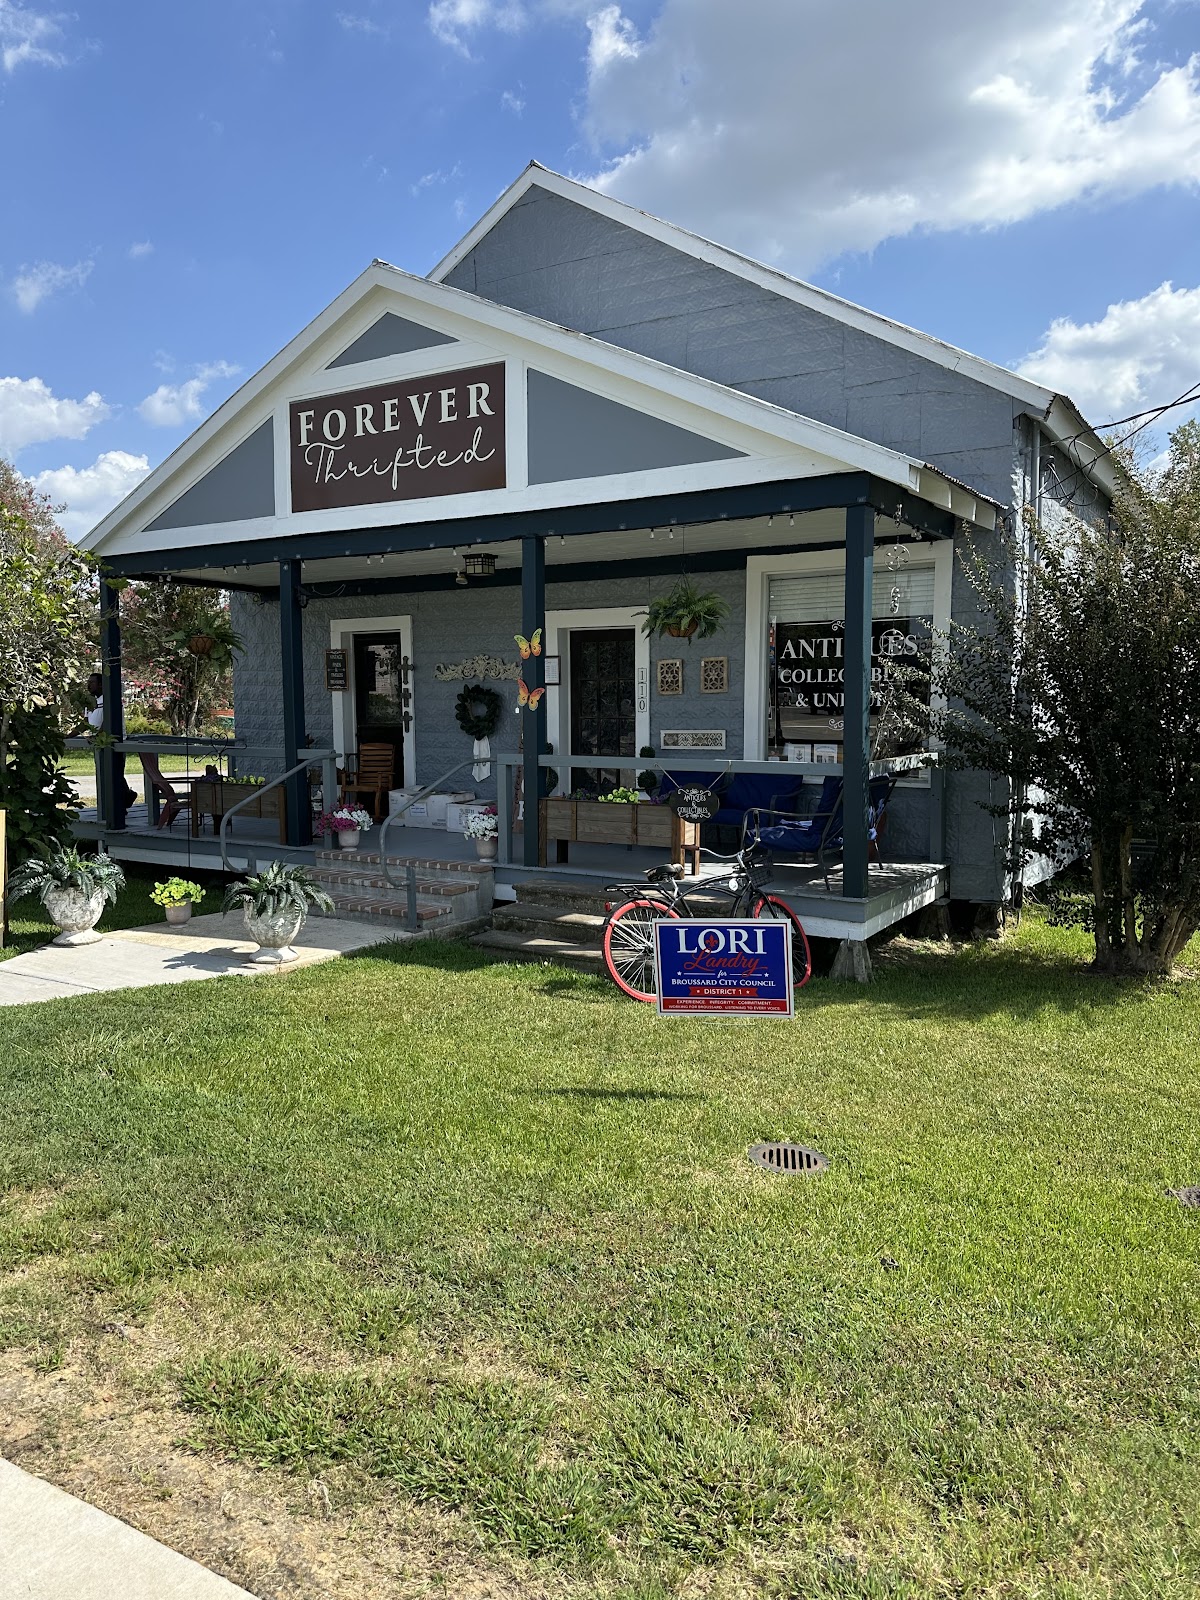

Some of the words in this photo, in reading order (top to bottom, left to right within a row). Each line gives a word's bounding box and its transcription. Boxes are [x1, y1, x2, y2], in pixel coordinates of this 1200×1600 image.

[297, 382, 495, 447] FOREVER
[304, 426, 495, 490] Thrifted
[780, 635, 918, 659] ANTIUES
[638, 669, 647, 711] 110
[795, 692, 809, 708] &
[683, 794, 707, 803] ANTIQUES
[675, 928, 767, 954] LORI
[684, 947, 768, 977] Landry
[717, 969, 728, 979] for
[671, 978, 717, 986] BROUSSARD
[718, 979, 738, 987] CITY
[739, 979, 776, 987] COUNCIL
